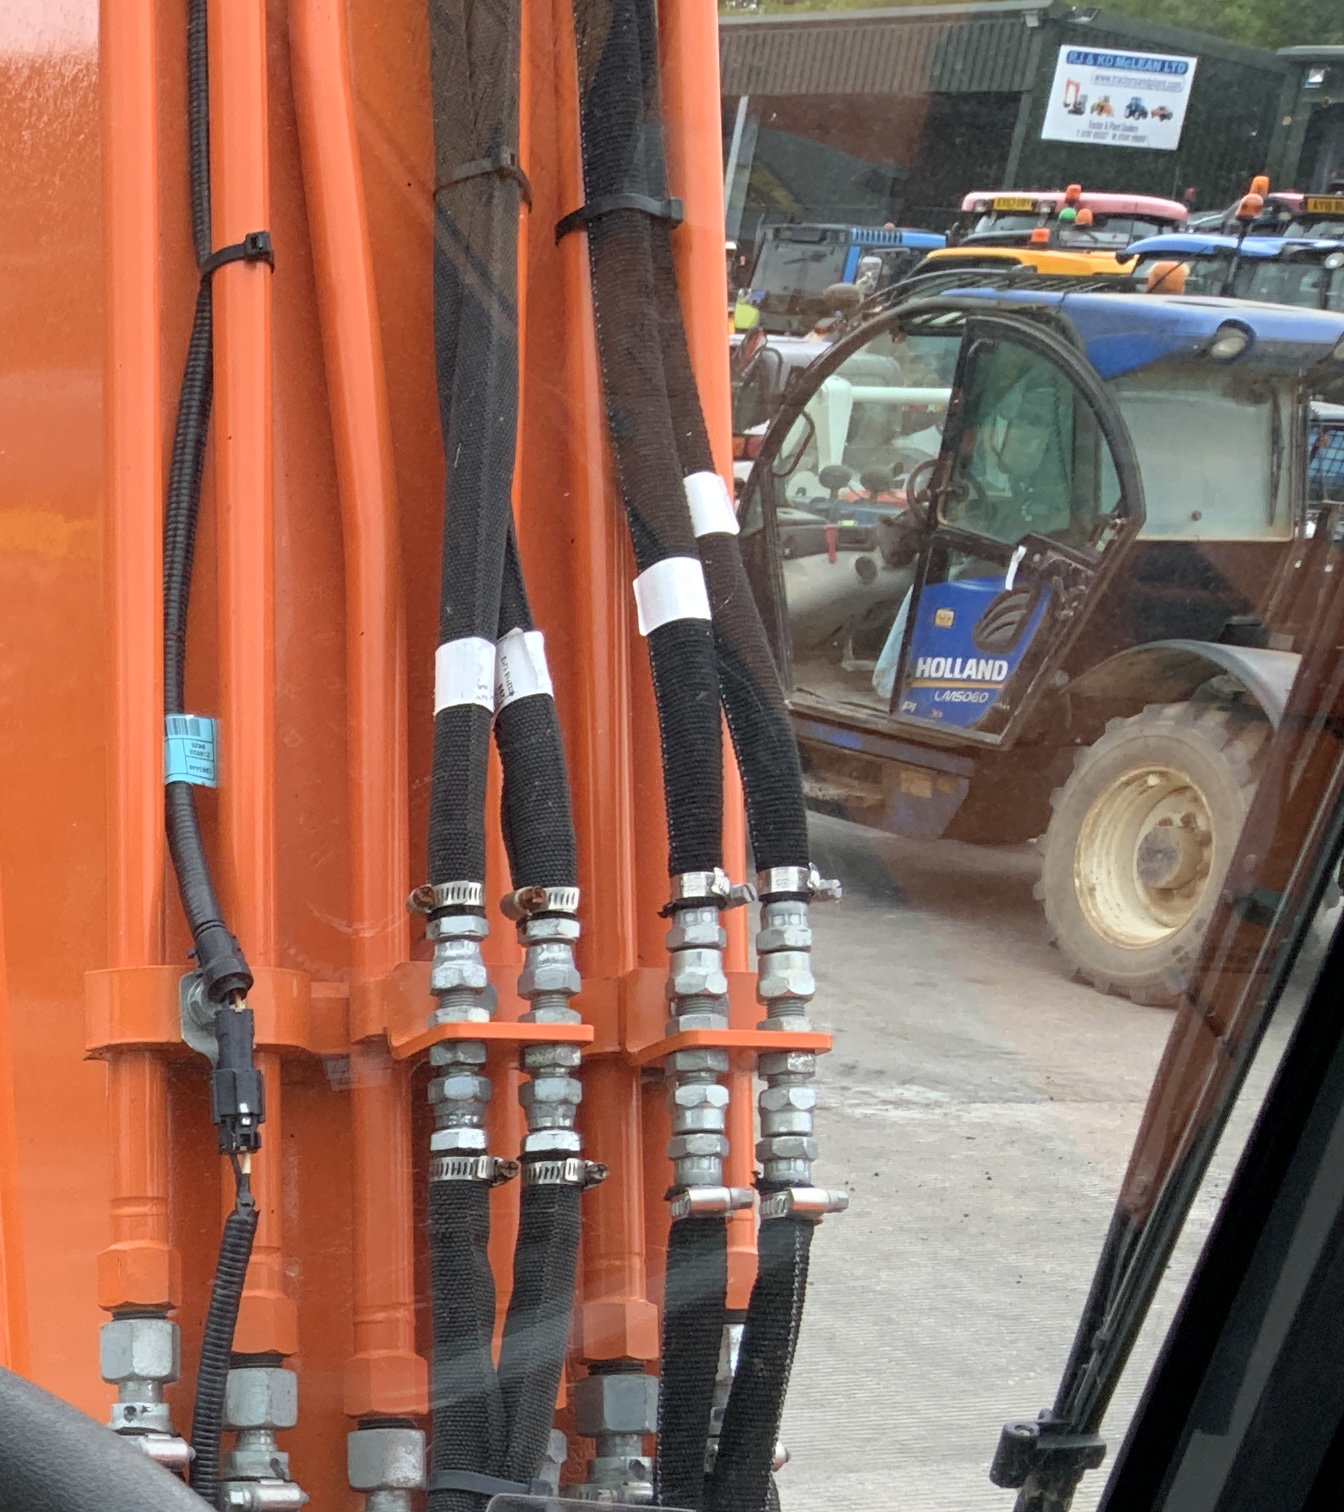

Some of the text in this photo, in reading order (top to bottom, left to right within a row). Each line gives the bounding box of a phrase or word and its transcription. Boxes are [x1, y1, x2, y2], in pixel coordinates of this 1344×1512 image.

[1163, 61, 1186, 73] LTD
[915, 657, 1009, 681] HOLLAND
[934, 690, 989, 703] LM5060
